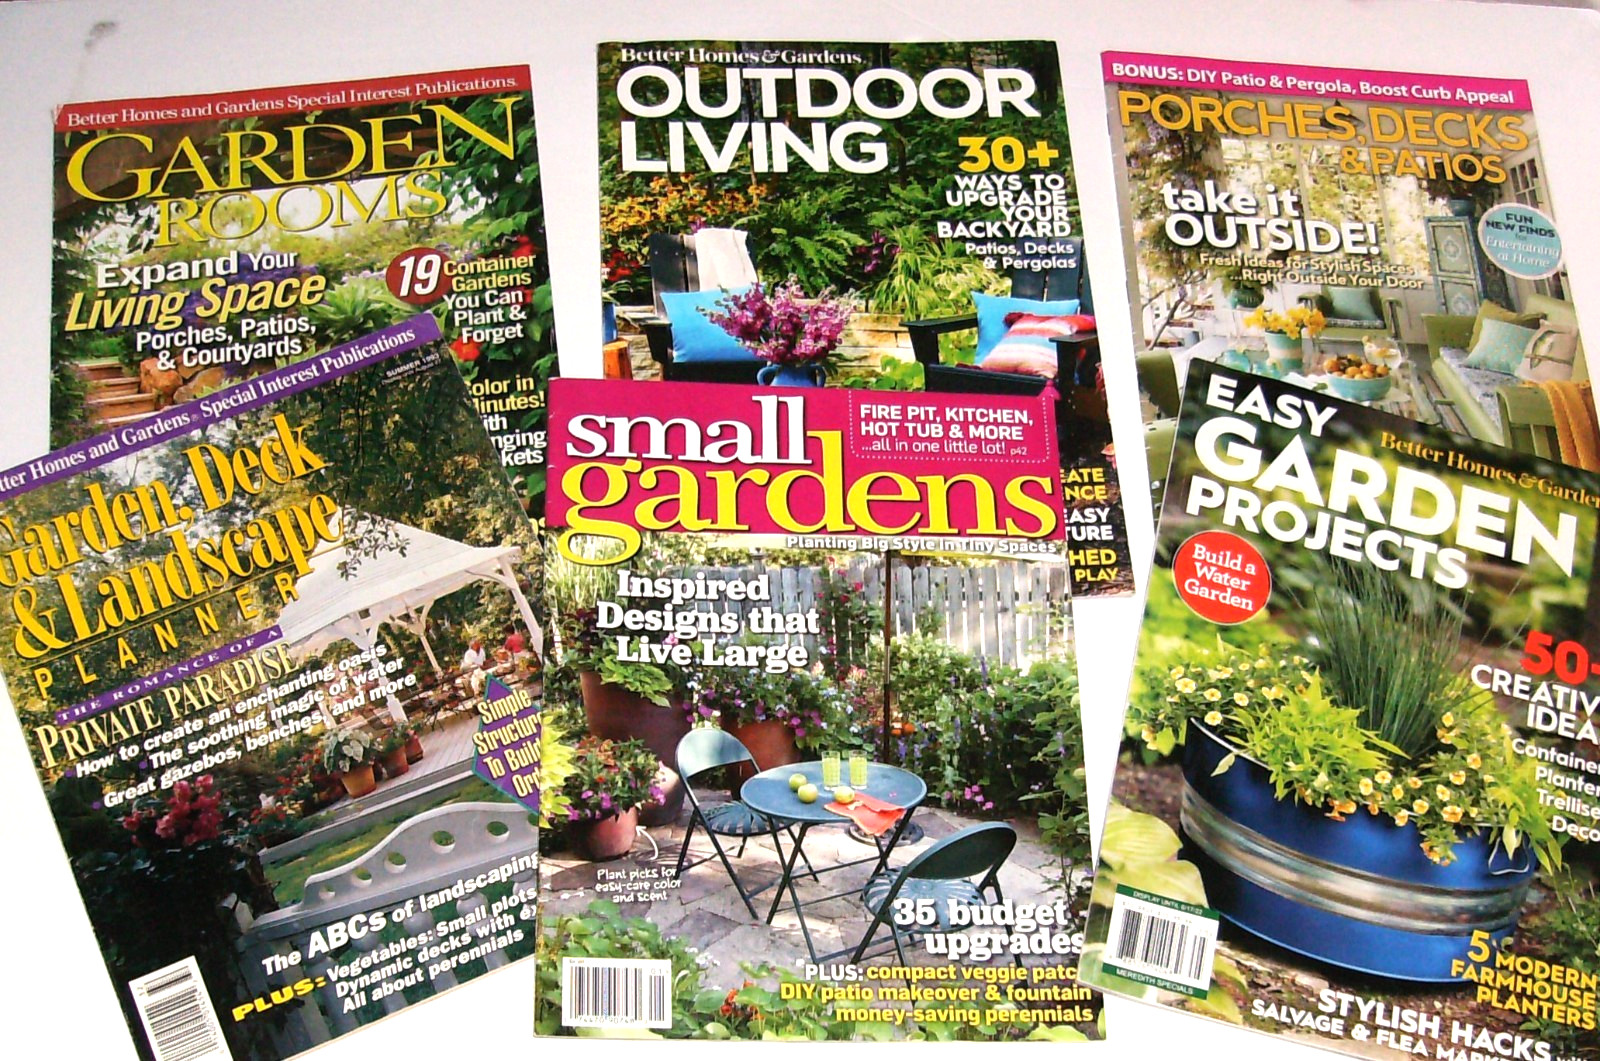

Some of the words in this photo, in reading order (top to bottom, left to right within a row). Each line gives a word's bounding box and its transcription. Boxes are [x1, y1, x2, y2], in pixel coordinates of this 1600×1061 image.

[621, 48, 684, 63] Better
[616, 65, 1041, 119] OUTDOOR
[1112, 62, 1184, 81] BONUS:
[1187, 69, 1217, 84] DIY
[1221, 71, 1265, 87] Patio
[1359, 81, 1408, 97] Boost
[1411, 84, 1451, 100] Curb
[1455, 88, 1514, 105] Appeal
[68, 112, 118, 127] Better
[122, 107, 177, 122] Homes
[181, 103, 212, 118] and
[215, 97, 284, 115] Gardens
[287, 91, 346, 110] Special
[1118, 91, 1366, 144] PORCHES,
[1368, 107, 1528, 151] DECKS
[66, 97, 524, 203] GARDEN
[621, 121, 889, 174] LIVING
[954, 174, 1022, 191] WAYS
[1029, 174, 1065, 191] TO
[1370, 149, 1507, 184] PATIOS
[154, 171, 447, 248] ROOMS
[945, 190, 1067, 206] UPGRADE
[1000, 206, 1069, 222] YOUR
[1160, 180, 1257, 214] take
[937, 221, 1071, 238] BACKYARD
[1165, 213, 1380, 255] OUTSIDE!
[1485, 220, 1515, 231] NEW
[1519, 225, 1555, 238] FINDS
[1505, 212, 1533, 224] FUN
[1002, 257, 1076, 272] Pergolas
[1024, 242, 1074, 254] Decks
[1200, 253, 1241, 266] Fresh
[1243, 254, 1283, 269] Ideas
[1286, 255, 1307, 269] for
[1310, 257, 1361, 274] Stylish
[1486, 236, 1560, 259] Entertaining
[1513, 252, 1550, 267] Home
[97, 250, 239, 290] Expand
[248, 251, 297, 271] Your
[443, 254, 536, 276] Container
[452, 271, 532, 293] Gardens
[1286, 271, 1346, 285] Outside
[1349, 274, 1383, 288] Your
[1386, 276, 1424, 289] Door
[64, 288, 190, 331] Living
[196, 274, 326, 323] Space
[442, 294, 480, 310] You
[485, 289, 523, 304] Can
[454, 307, 505, 326] Plant
[136, 325, 233, 351] Porches,
[462, 323, 524, 345] Forget
[183, 338, 301, 365] Courtyards
[386, 360, 421, 377] SUMMER
[517, 374, 534, 391] in
[29, 451, 87, 481] Homes
[90, 434, 120, 459] and
[200, 387, 257, 418] Special
[259, 363, 321, 397] Interest
[320, 328, 416, 374] Publications
[860, 404, 902, 420] FIRE
[1206, 374, 1338, 437] EASY
[566, 395, 813, 464] small
[860, 421, 900, 436] HOT
[904, 422, 944, 438] TUB
[969, 425, 1023, 440] MORE
[183, 412, 328, 512] Deck
[895, 439, 908, 451] in
[912, 441, 939, 453] one
[944, 439, 978, 454] little
[982, 441, 1005, 455] lot!
[1010, 447, 1027, 457] p42
[1381, 431, 1444, 463] Better
[557, 430, 1057, 565] gardens
[1194, 416, 1577, 578] GARDEN
[787, 536, 857, 551] Planting
[893, 537, 934, 552] Style
[998, 540, 1056, 553] Spaces
[1186, 475, 1468, 589] PROJECTS
[55, 494, 344, 644] Landscape
[1192, 543, 1242, 571] Build
[616, 570, 770, 605] Inspired
[1075, 567, 1118, 582] PLAY
[1194, 562, 1251, 590] Water
[1184, 578, 1253, 611] Garden
[34, 573, 298, 700] PLANNER
[596, 600, 739, 640] Designs
[748, 607, 820, 634] that
[616, 635, 692, 666] Live
[701, 639, 808, 674] Large
[58, 700, 102, 721] THE
[113, 651, 220, 701] ROMANCE
[1471, 664, 1600, 717] CREATIV
[34, 695, 162, 769] PRIVATE
[163, 641, 301, 720] PARADISE
[76, 755, 114, 778] How
[143, 720, 204, 751] create
[208, 707, 230, 725] an
[235, 664, 336, 713] enchanting
[338, 642, 387, 672] oasis
[149, 747, 182, 770] The
[188, 712, 267, 755] soothing
[270, 690, 325, 721] magic
[353, 655, 404, 686] water
[477, 689, 532, 725] Simple
[103, 775, 156, 809] Great
[245, 709, 329, 751] benches,
[332, 693, 365, 716] and
[369, 673, 416, 701] more
[483, 756, 506, 779] To
[504, 738, 541, 772] Build
[597, 868, 626, 880] Plant
[630, 867, 658, 881] picks
[653, 878, 682, 889] color
[612, 892, 634, 903] and
[1133, 890, 1160, 904] DISPLAY
[1161, 898, 1179, 908] UNTIL
[893, 898, 936, 925] 35
[947, 898, 1068, 933] budget
[262, 950, 302, 976] The
[307, 908, 387, 958] ABCs
[326, 929, 435, 983] Vegetables:
[435, 905, 486, 938] Small
[335, 958, 413, 998] Dynamic
[417, 932, 471, 962] decks
[476, 911, 516, 939] with
[924, 931, 1084, 962] upgrades
[343, 990, 366, 1014] All
[371, 968, 425, 1003] about
[428, 927, 524, 982] perennials
[805, 964, 864, 981] PLUS:
[866, 964, 956, 983] compact
[961, 964, 1027, 984] veggie
[1116, 968, 1156, 985] MEREDITH
[1157, 979, 1193, 995] SPECIALS
[1451, 959, 1596, 1011] FARMHOUSE
[1495, 951, 1598, 991] MODERN
[780, 983, 815, 1000] DIY
[821, 982, 874, 1003] patio
[878, 984, 980, 1001] makeover
[1006, 983, 1092, 1001] fountain
[1476, 985, 1596, 1031] PLANTERS
[836, 1006, 980, 1026] money-saving
[985, 1006, 1094, 1026] perennials
[1251, 999, 1344, 1036] SALVAGE
[1376, 1029, 1428, 1057] FLEA
[1318, 988, 1440, 1038] STYLISH
[1451, 1020, 1552, 1061] HACKS
